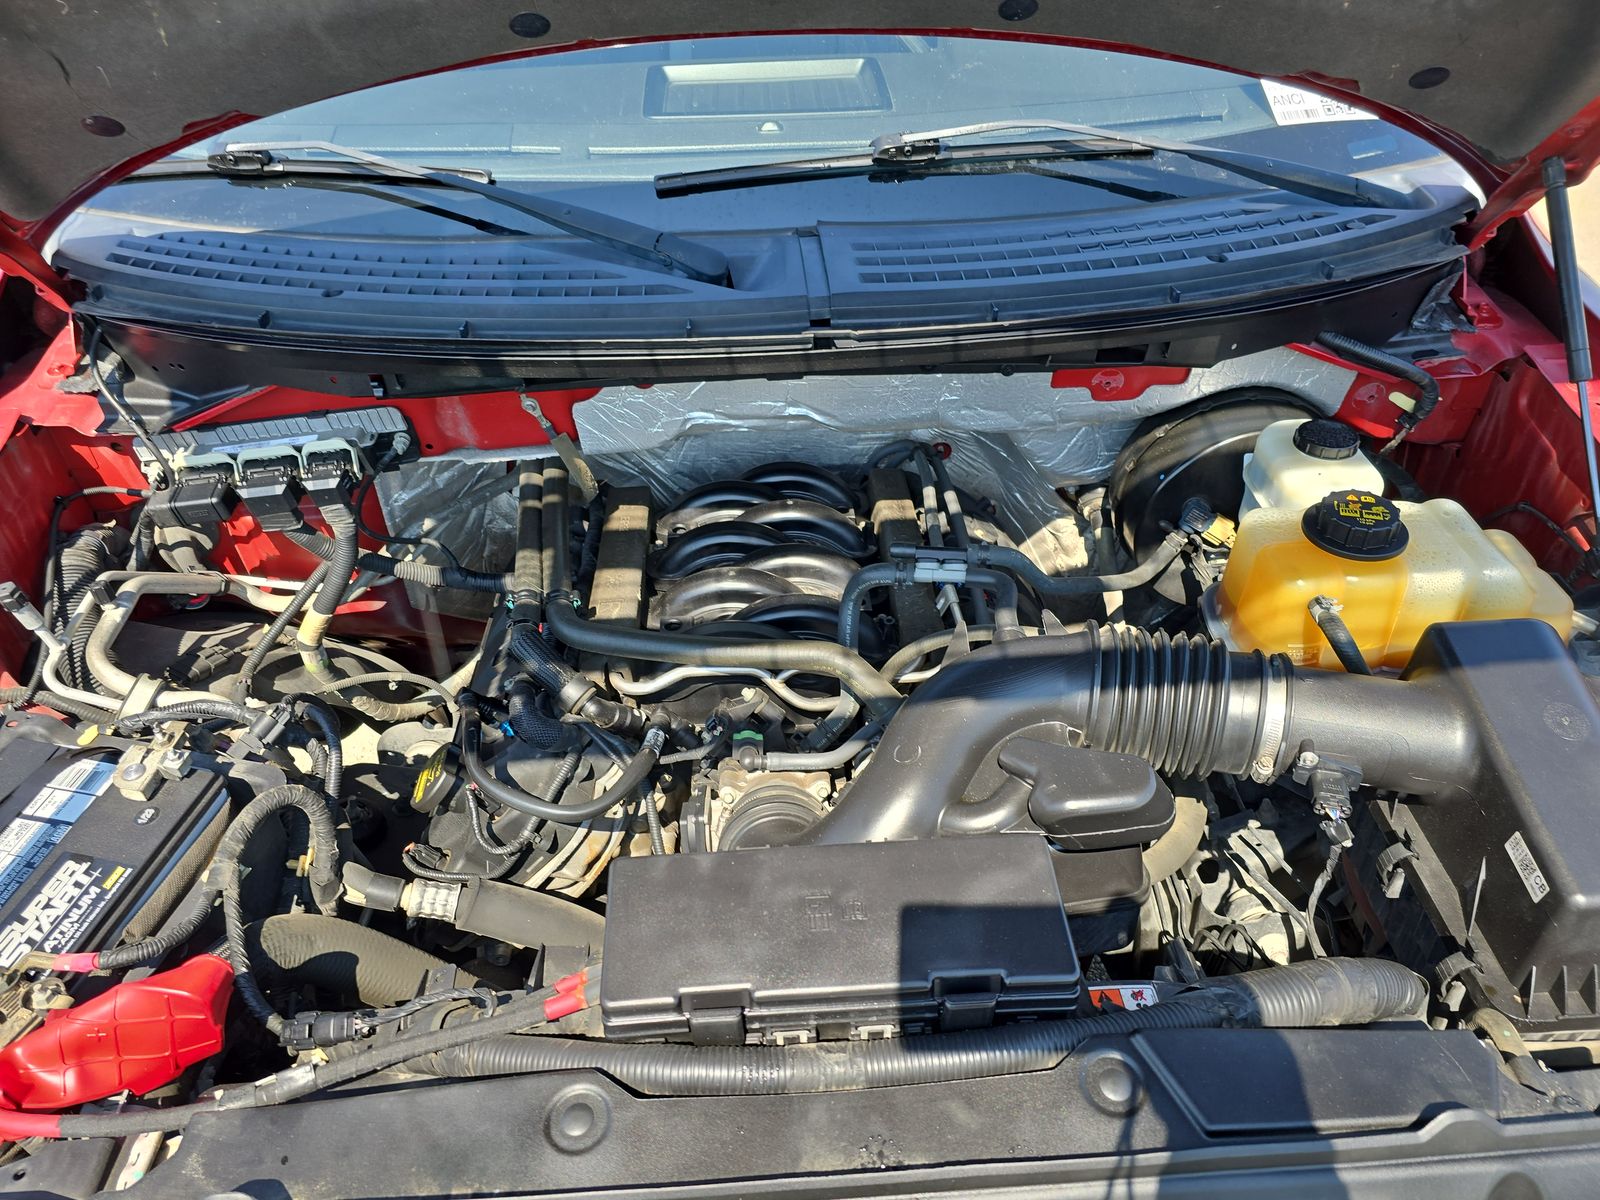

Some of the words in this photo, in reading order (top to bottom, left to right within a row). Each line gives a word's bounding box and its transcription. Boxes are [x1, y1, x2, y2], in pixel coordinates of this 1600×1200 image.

[0, 860, 82, 959] SUPER
[0, 861, 92, 967] START
[43, 886, 102, 953] ATINUM
